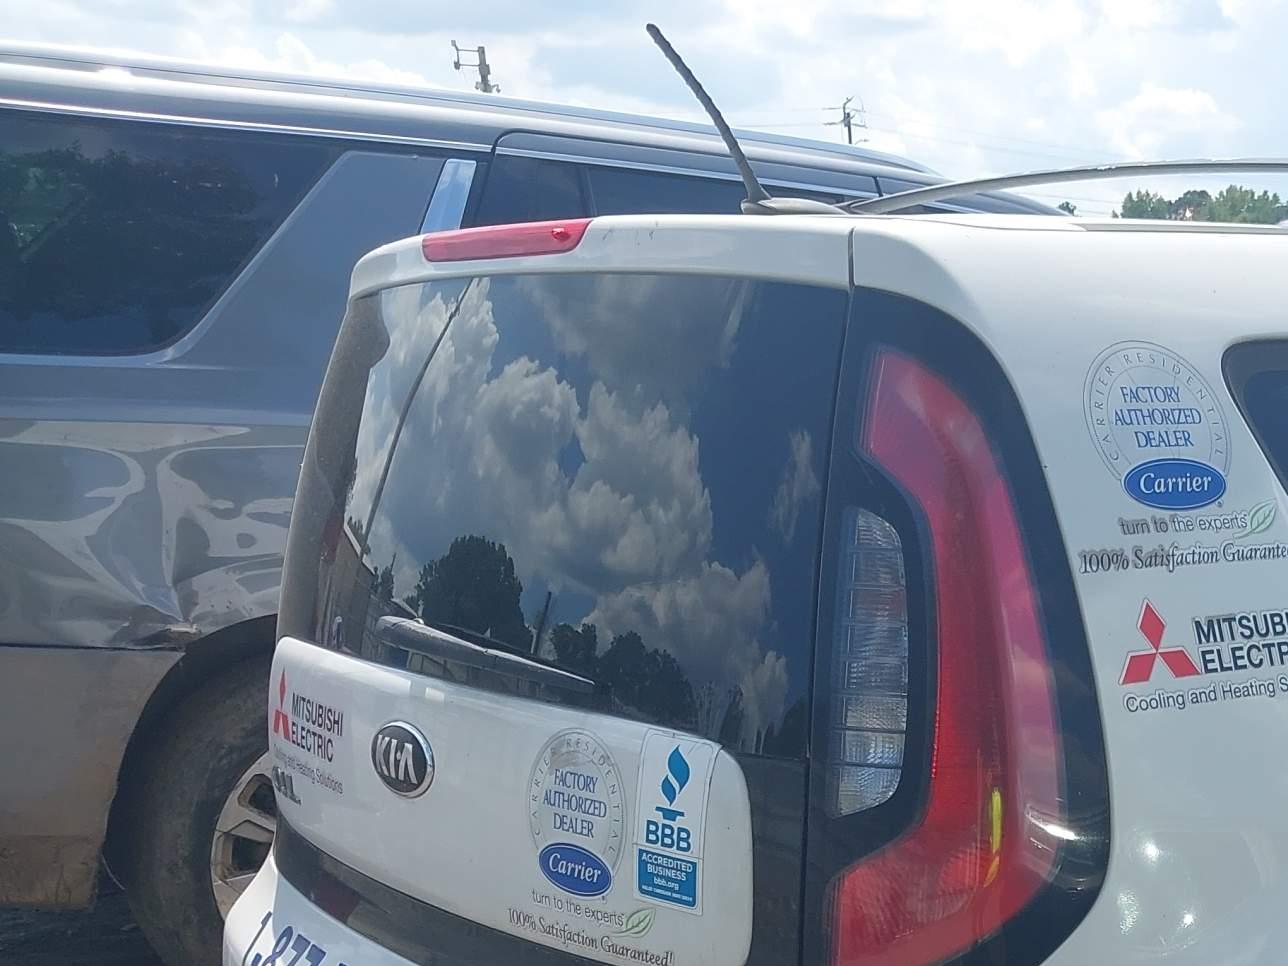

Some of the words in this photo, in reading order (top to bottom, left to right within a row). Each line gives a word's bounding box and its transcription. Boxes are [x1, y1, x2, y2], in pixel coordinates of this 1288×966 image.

[1120, 386, 1180, 403] FACTORY
[1113, 408, 1202, 426] AUTHORIZED
[1134, 430, 1194, 448] DEALER
[1139, 472, 1212, 494] Carrier
[1120, 519, 1149, 535] turn
[1154, 516, 1168, 533] to
[1172, 514, 1194, 532] the
[1080, 551, 1130, 574] 100%
[1134, 543, 1219, 573] Satisfaction
[1125, 686, 1186, 713] Cooling
[1191, 684, 1217, 703] and
[1222, 677, 1276, 699] Heating
[292, 693, 344, 737] MITSUBISHI
[291, 722, 334, 763] ELECTRIC
[375, 734, 418, 784] KIA
[553, 768, 599, 793] FACTORY
[543, 789, 607, 818] AUTHORIZED
[553, 813, 594, 838] DEALER
[646, 819, 691, 852] BBB
[549, 853, 602, 884] Carrier
[641, 852, 693, 873] ACCREDITED
[647, 863, 687, 881] BUSINESS
[653, 876, 680, 891] bbb.org
[532, 888, 551, 907] turn
[553, 894, 563, 910] to
[565, 898, 581, 916] the
[508, 907, 536, 931] 100%
[539, 917, 598, 949] Satisfaction
